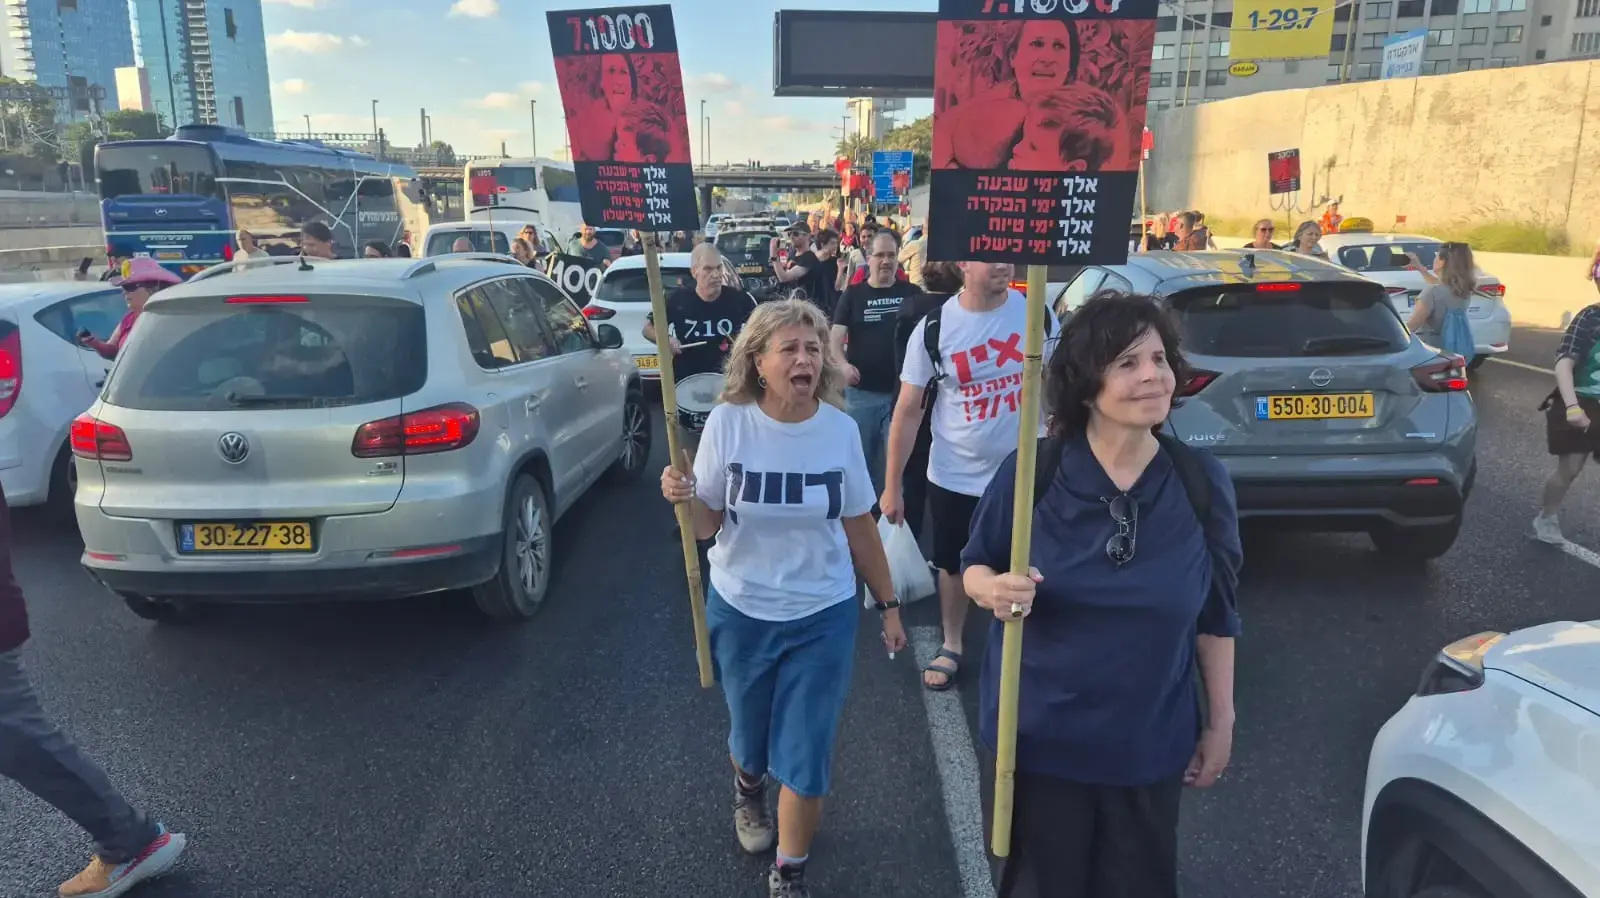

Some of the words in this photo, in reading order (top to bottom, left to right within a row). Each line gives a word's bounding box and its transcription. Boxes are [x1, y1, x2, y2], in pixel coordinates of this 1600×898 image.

[1247, 8, 1318, 31] 1-29.7
[598, 165, 627, 176] שבעה
[628, 167, 640, 178] ימי
[643, 165, 667, 180] אלף
[595, 180, 629, 193] הפקרה
[631, 183, 643, 193] ימי
[645, 181, 668, 196] אלף
[977, 176, 1028, 191] שבעה
[1034, 178, 1058, 192] ימי
[1063, 176, 1098, 195] אלף
[611, 195, 631, 207] טיוח
[632, 198, 644, 208] ימי
[646, 196, 670, 211] אלף
[967, 196, 1026, 213] הפקרה
[1032, 199, 1056, 213] ימי
[1061, 197, 1096, 216] אלף
[602, 207, 633, 222] כישלון
[634, 211, 645, 223] ימי
[647, 211, 672, 226] אלף
[989, 217, 1024, 232] טיוח
[1030, 219, 1054, 234] ימי
[1059, 217, 1094, 236] אלף
[970, 234, 1023, 253] כישלון
[1028, 239, 1052, 253] ימי
[1057, 238, 1091, 256] אלף
[867, 297, 904, 306] PATIENC
[684, 318, 733, 339] 7.10
[950, 333, 1024, 385] אין
[960, 383, 982, 397] על
[986, 372, 1023, 393] נינה
